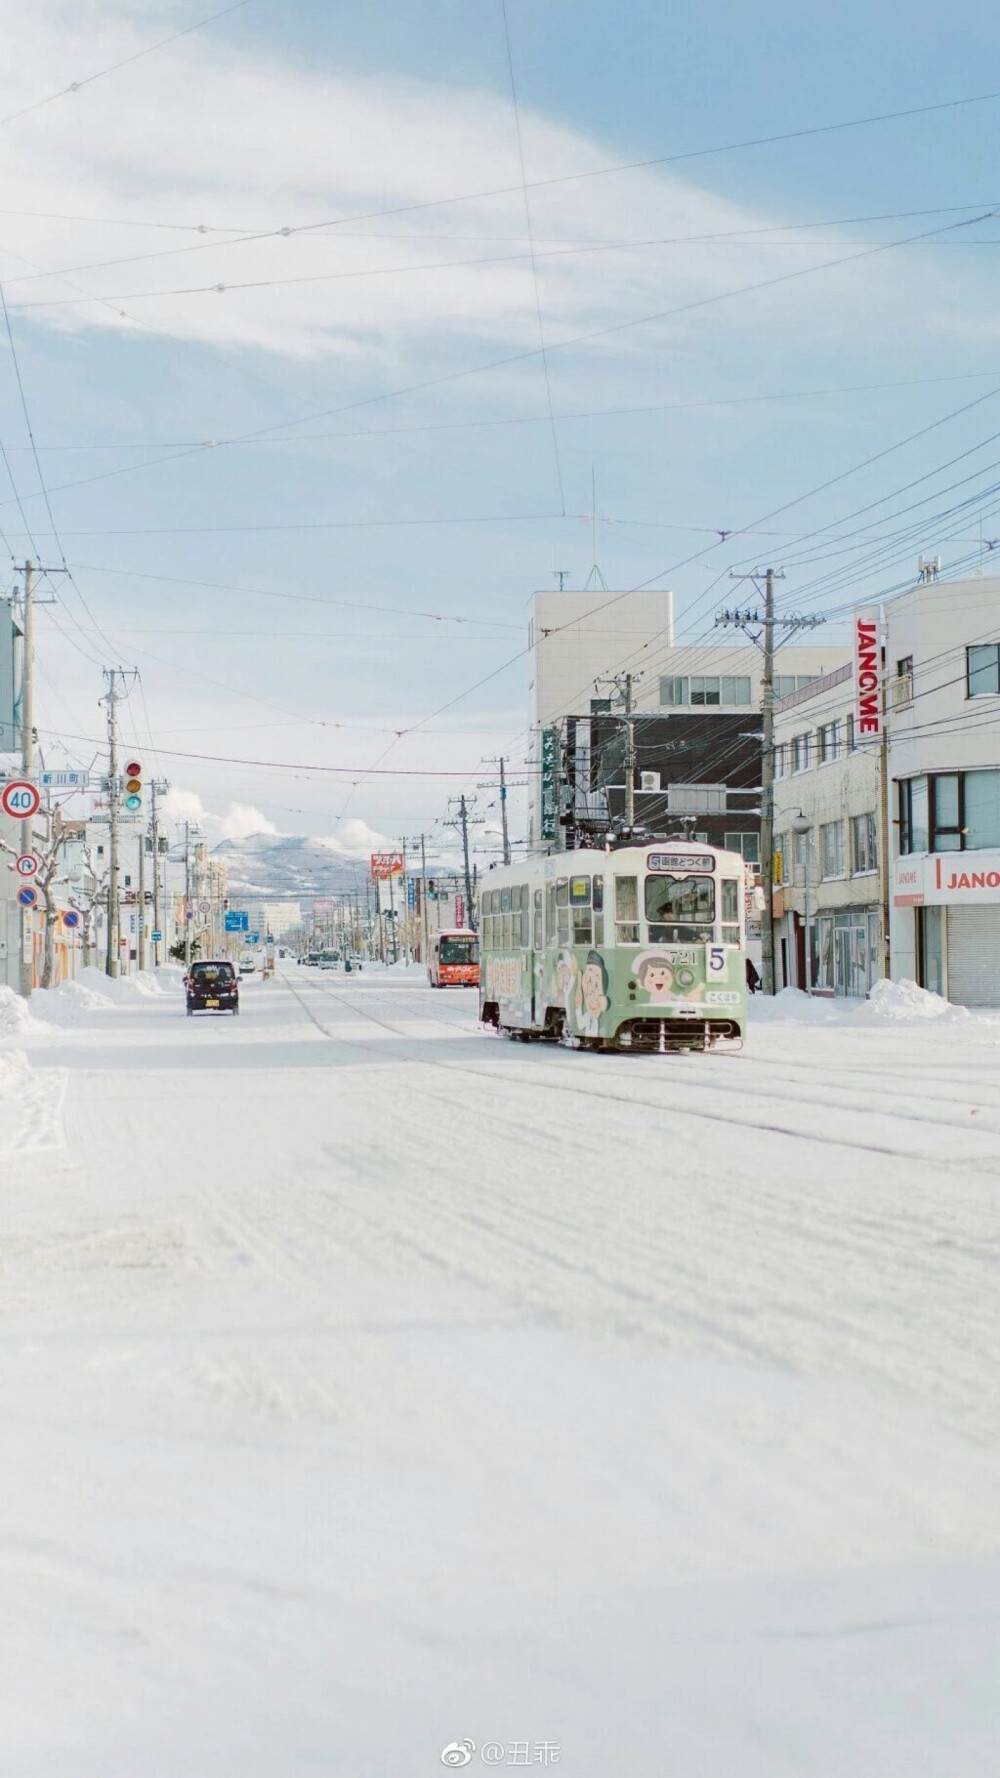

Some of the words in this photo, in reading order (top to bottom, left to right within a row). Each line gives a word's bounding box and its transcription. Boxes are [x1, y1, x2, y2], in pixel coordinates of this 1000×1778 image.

[857, 618, 879, 733] JANOME
[10, 792, 31, 808] 40
[651, 856, 660, 868] 5
[947, 872, 1000, 889] JANO
[670, 952, 696, 964] 721
[709, 948, 724, 970] 5
